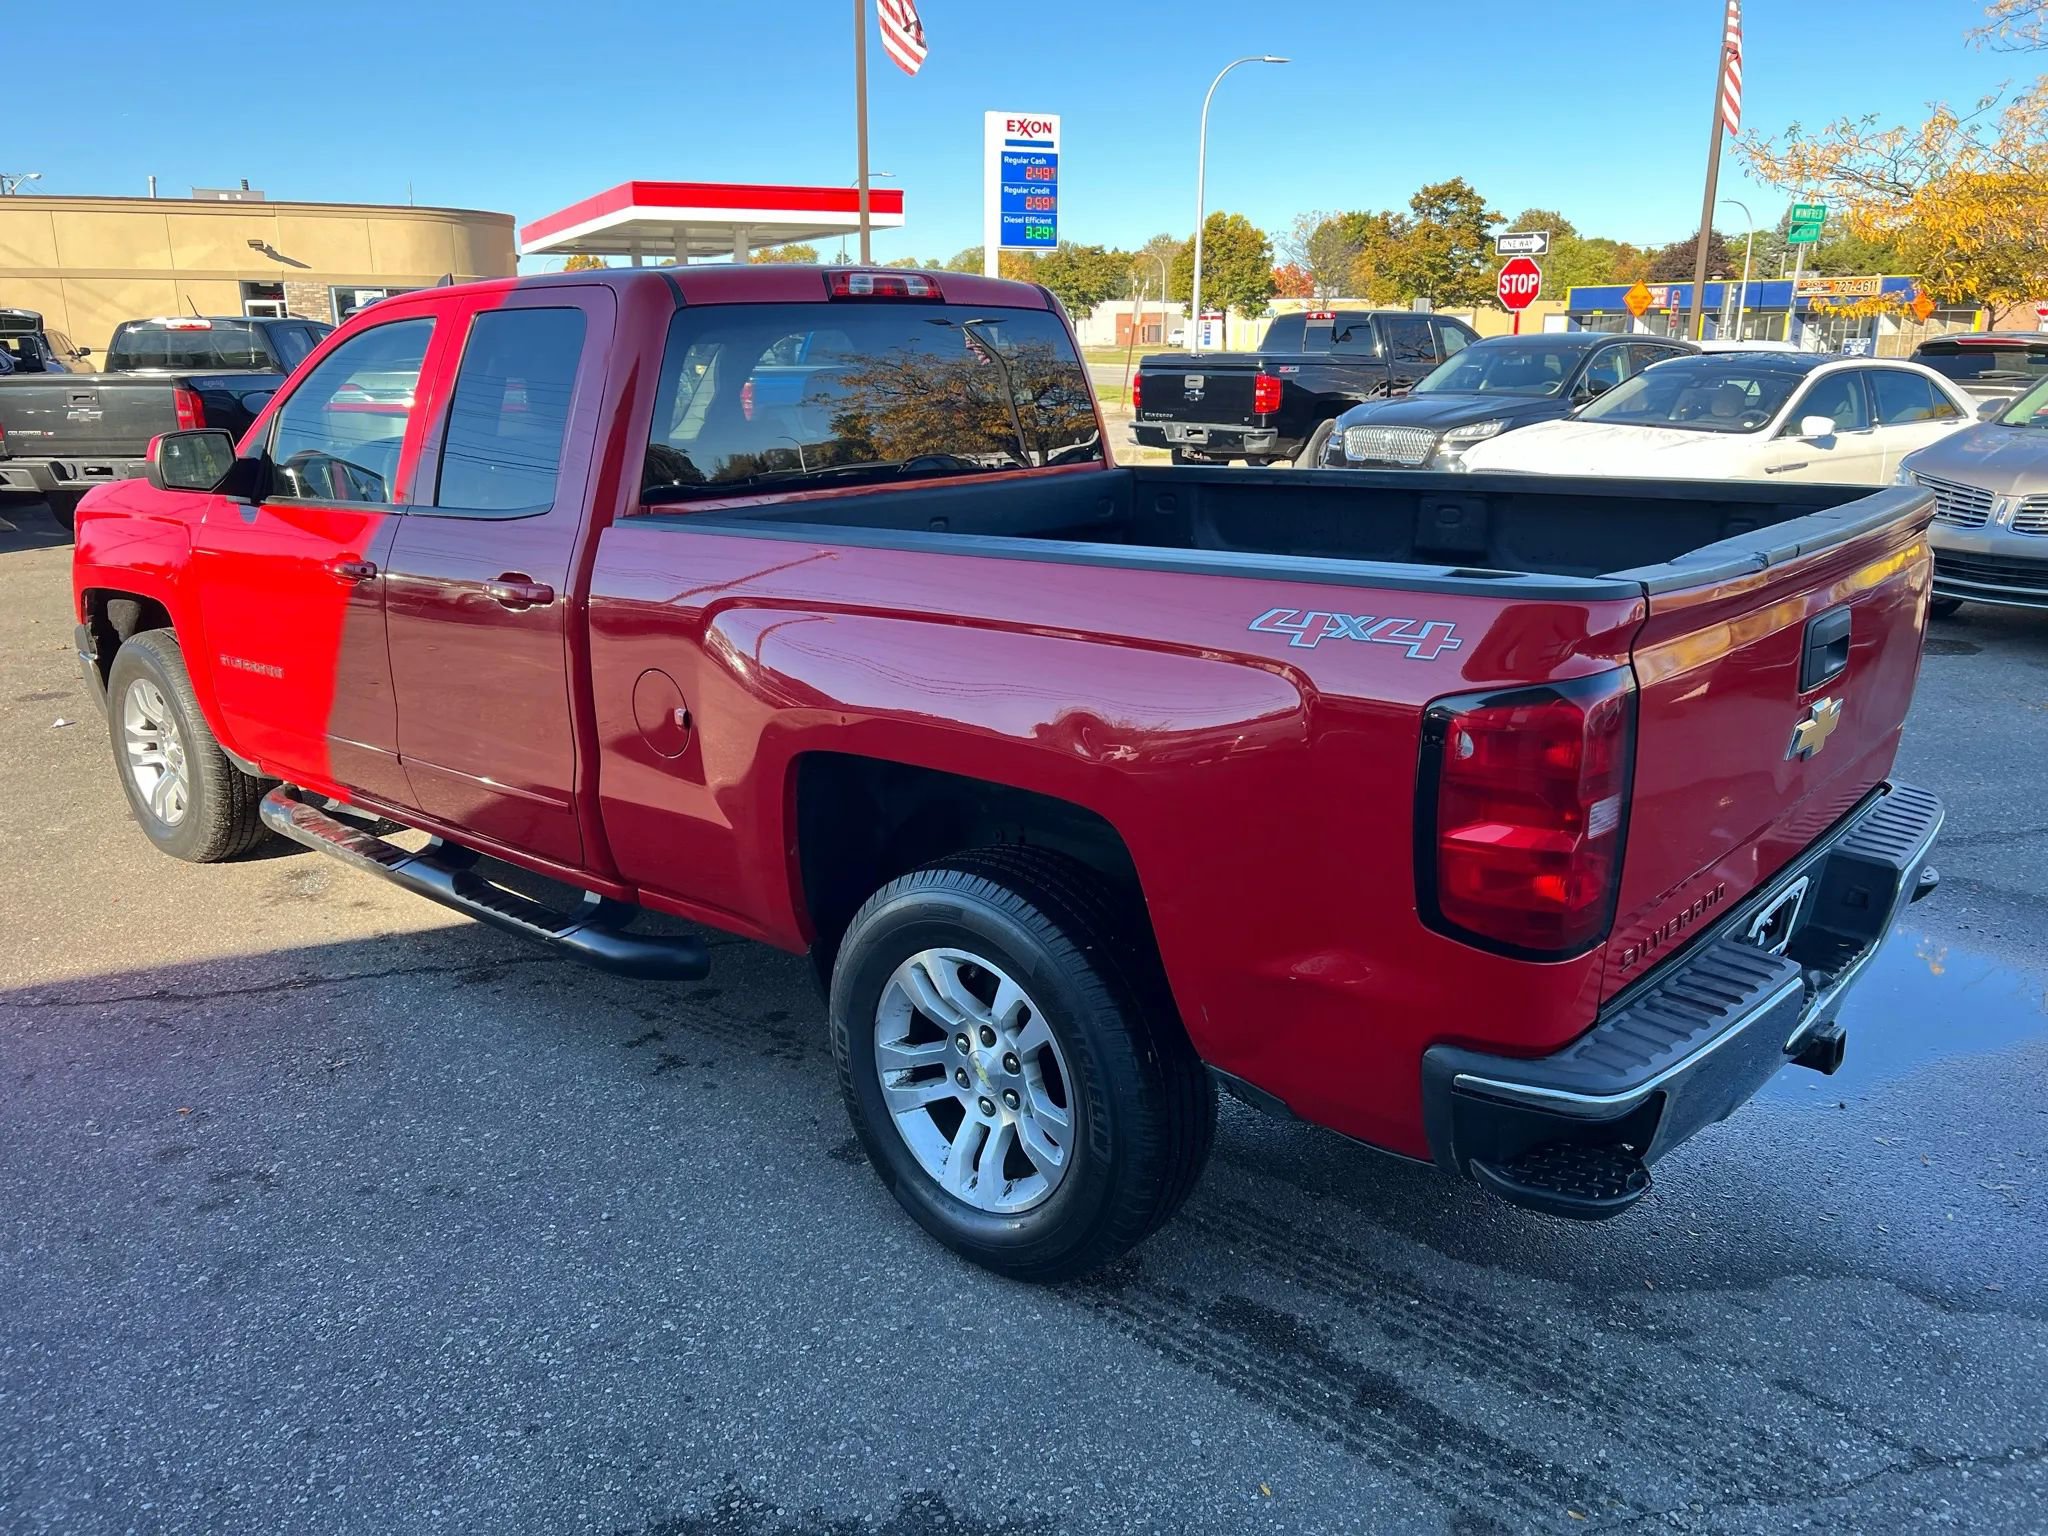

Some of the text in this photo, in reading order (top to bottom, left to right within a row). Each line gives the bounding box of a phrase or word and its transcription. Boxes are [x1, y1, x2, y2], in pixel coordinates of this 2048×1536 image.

[1007, 118, 1052, 138] EXXON
[1004, 156, 1046, 165] Regular Cash
[1004, 186, 1050, 195] Regular Credit
[1004, 216, 1052, 225] Diesel Efficient
[1502, 240, 1533, 248] ONE WAY
[1501, 273, 1539, 295] STOP
[1834, 281, 1878, 293] 727-4611
[1618, 882, 1725, 973] SILVERADO
